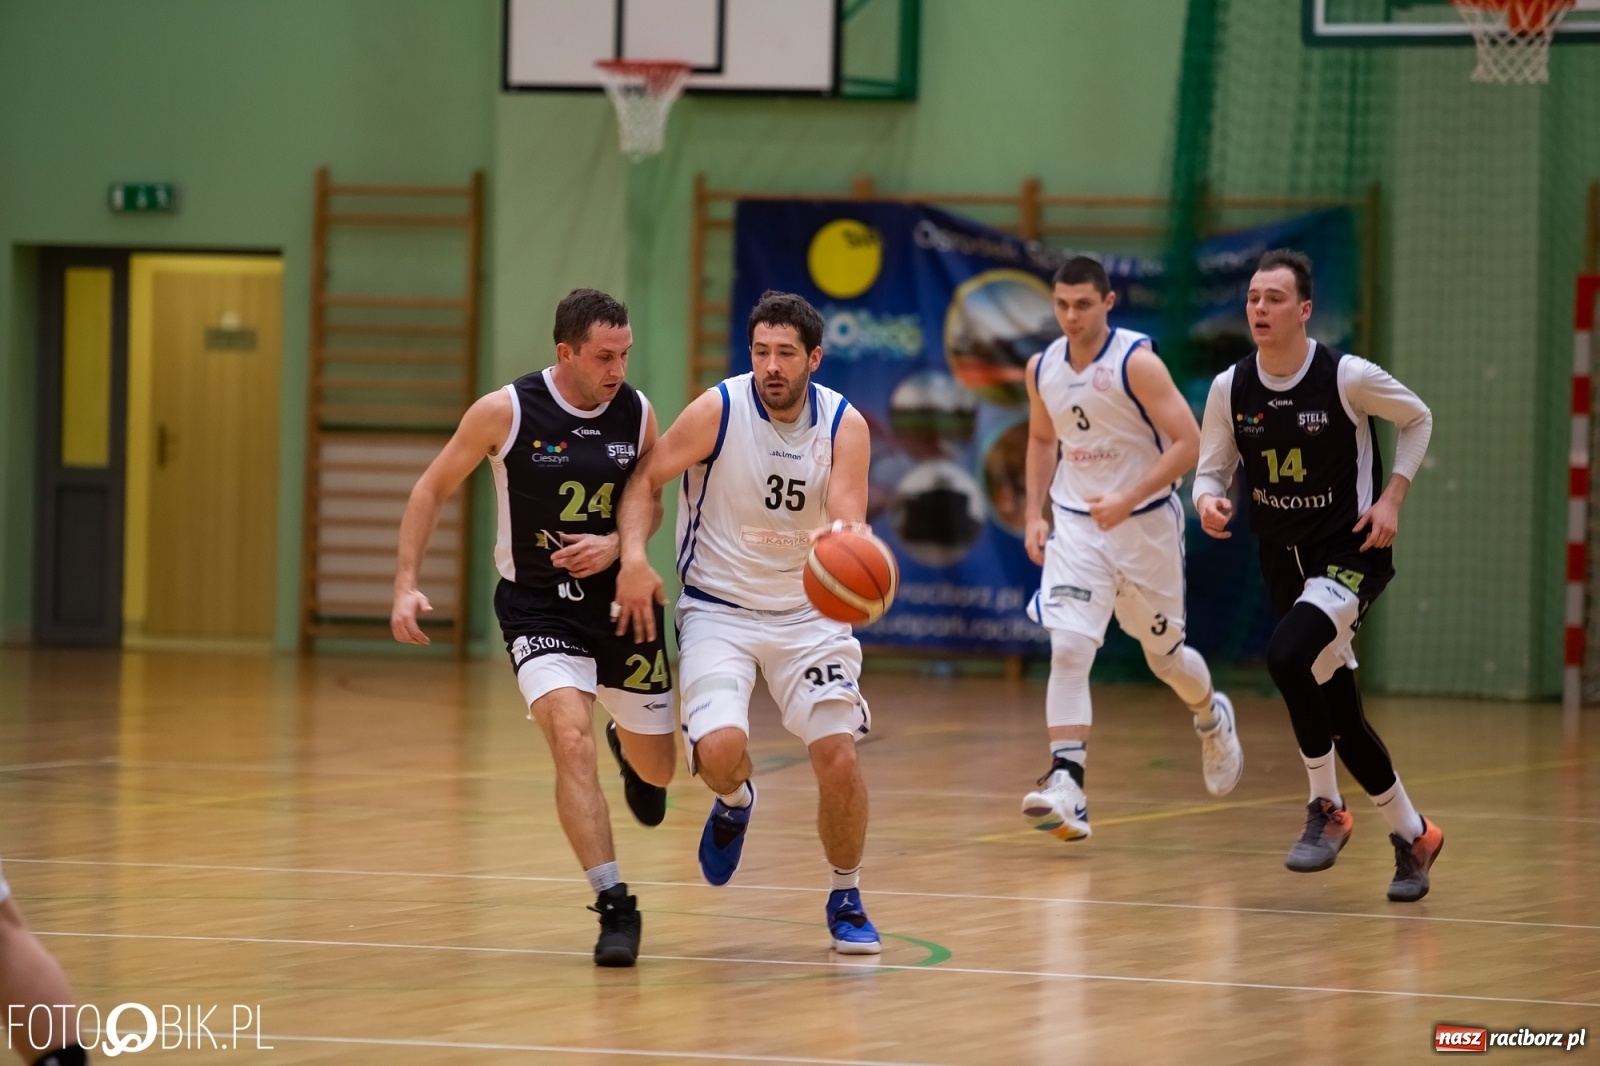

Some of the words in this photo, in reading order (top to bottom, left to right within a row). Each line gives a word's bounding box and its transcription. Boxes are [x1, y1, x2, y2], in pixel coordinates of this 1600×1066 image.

[1071, 405, 1091, 431] 3
[1299, 413, 1328, 426] STELA
[531, 452, 570, 464] Cieszyn
[607, 444, 636, 457] STELA
[1261, 448, 1307, 483] 14
[558, 480, 615, 521] 24
[764, 474, 807, 512] 35
[1252, 486, 1333, 510] Nacomi
[1151, 613, 1168, 636] 3
[623, 649, 669, 690] 24
